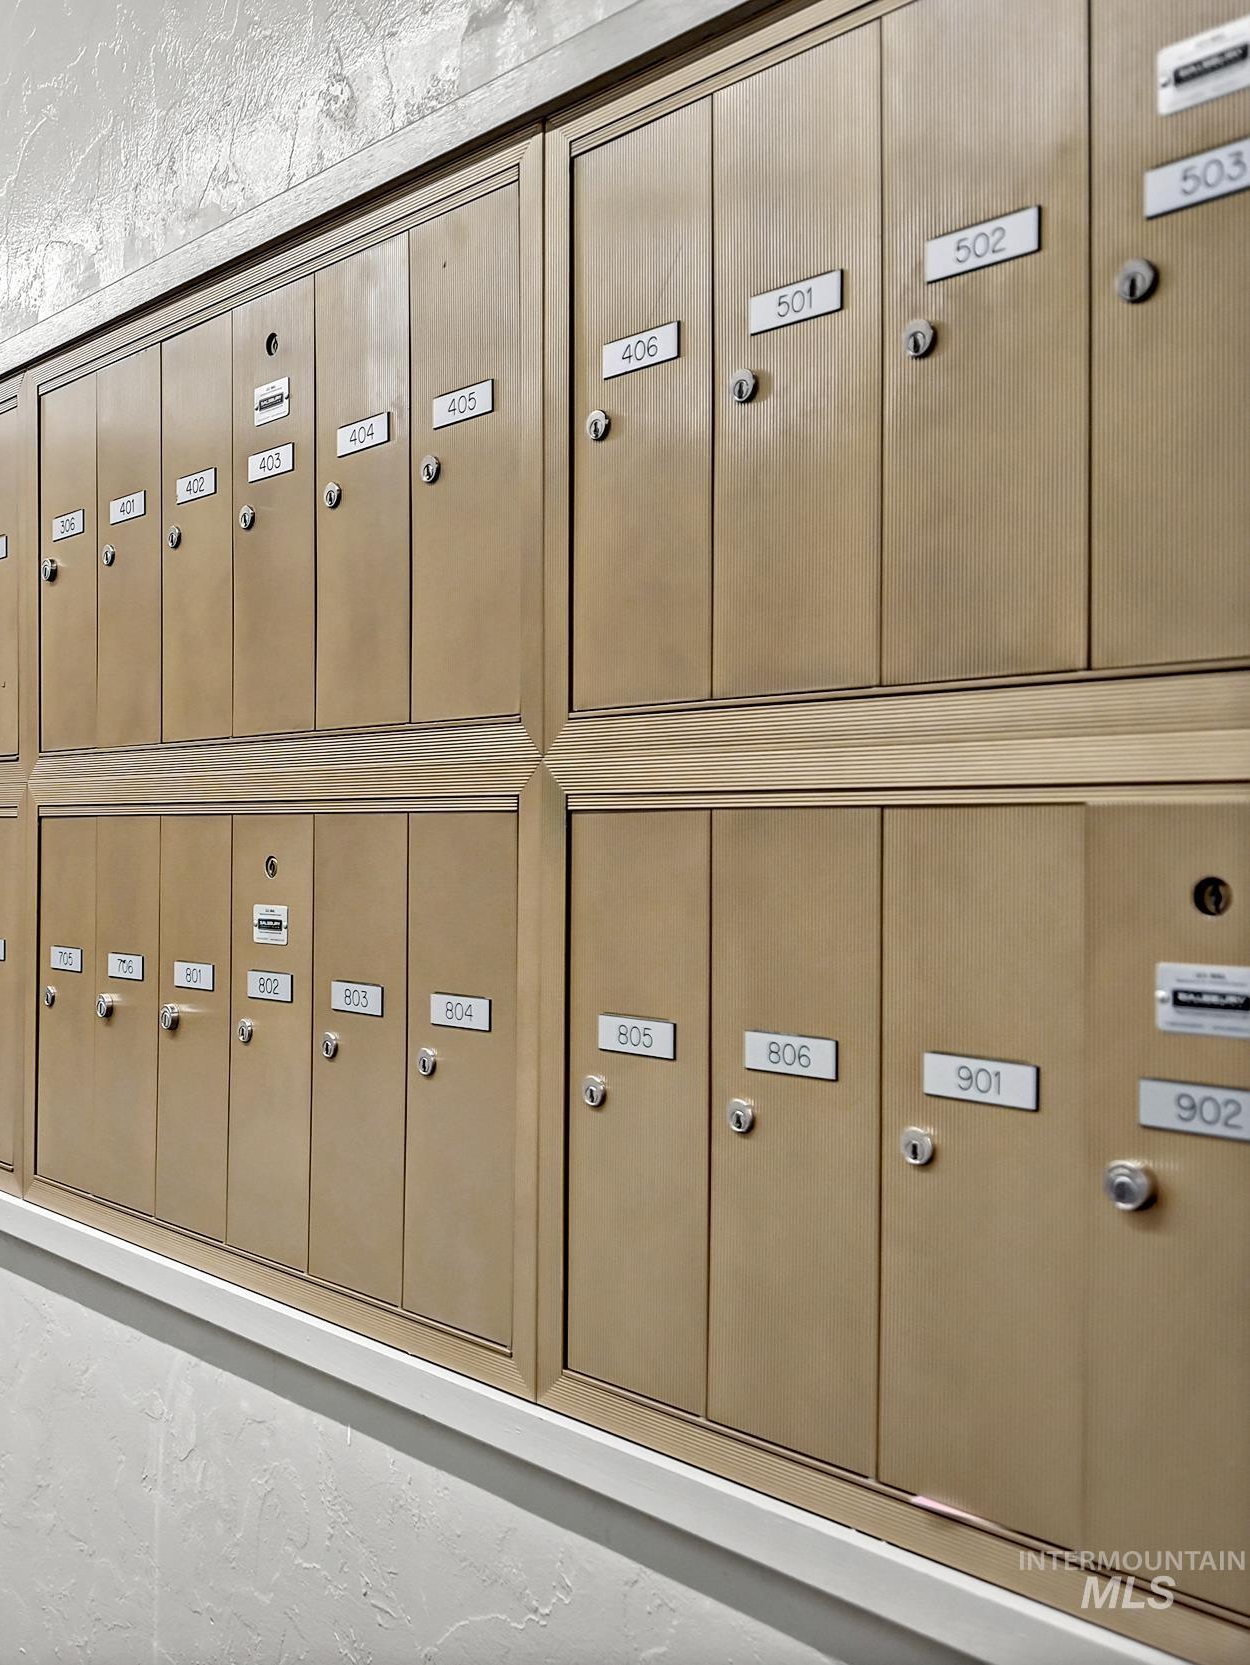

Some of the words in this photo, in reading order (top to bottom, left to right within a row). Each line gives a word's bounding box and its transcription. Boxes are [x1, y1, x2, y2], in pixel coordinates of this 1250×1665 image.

[1181, 151, 1247, 195] 503
[954, 228, 1007, 265] 502
[777, 288, 814, 318] 501
[621, 335, 659, 365] 406
[447, 391, 477, 416] 405
[349, 423, 375, 446] 404
[259, 453, 281, 472] 403
[185, 477, 205, 495] 402
[119, 499, 136, 517] 401
[59, 517, 76, 535] 306
[58, 951, 73, 966] 705
[117, 958, 135, 974] 706
[185, 967, 202, 984] 801
[258, 977, 280, 996] 802
[344, 988, 369, 1009] 803
[444, 1000, 474, 1022] 804
[617, 1024, 654, 1049] 805
[767, 1041, 812, 1069] 806
[957, 1065, 1002, 1097] 901
[1176, 1092, 1244, 1130] 902
